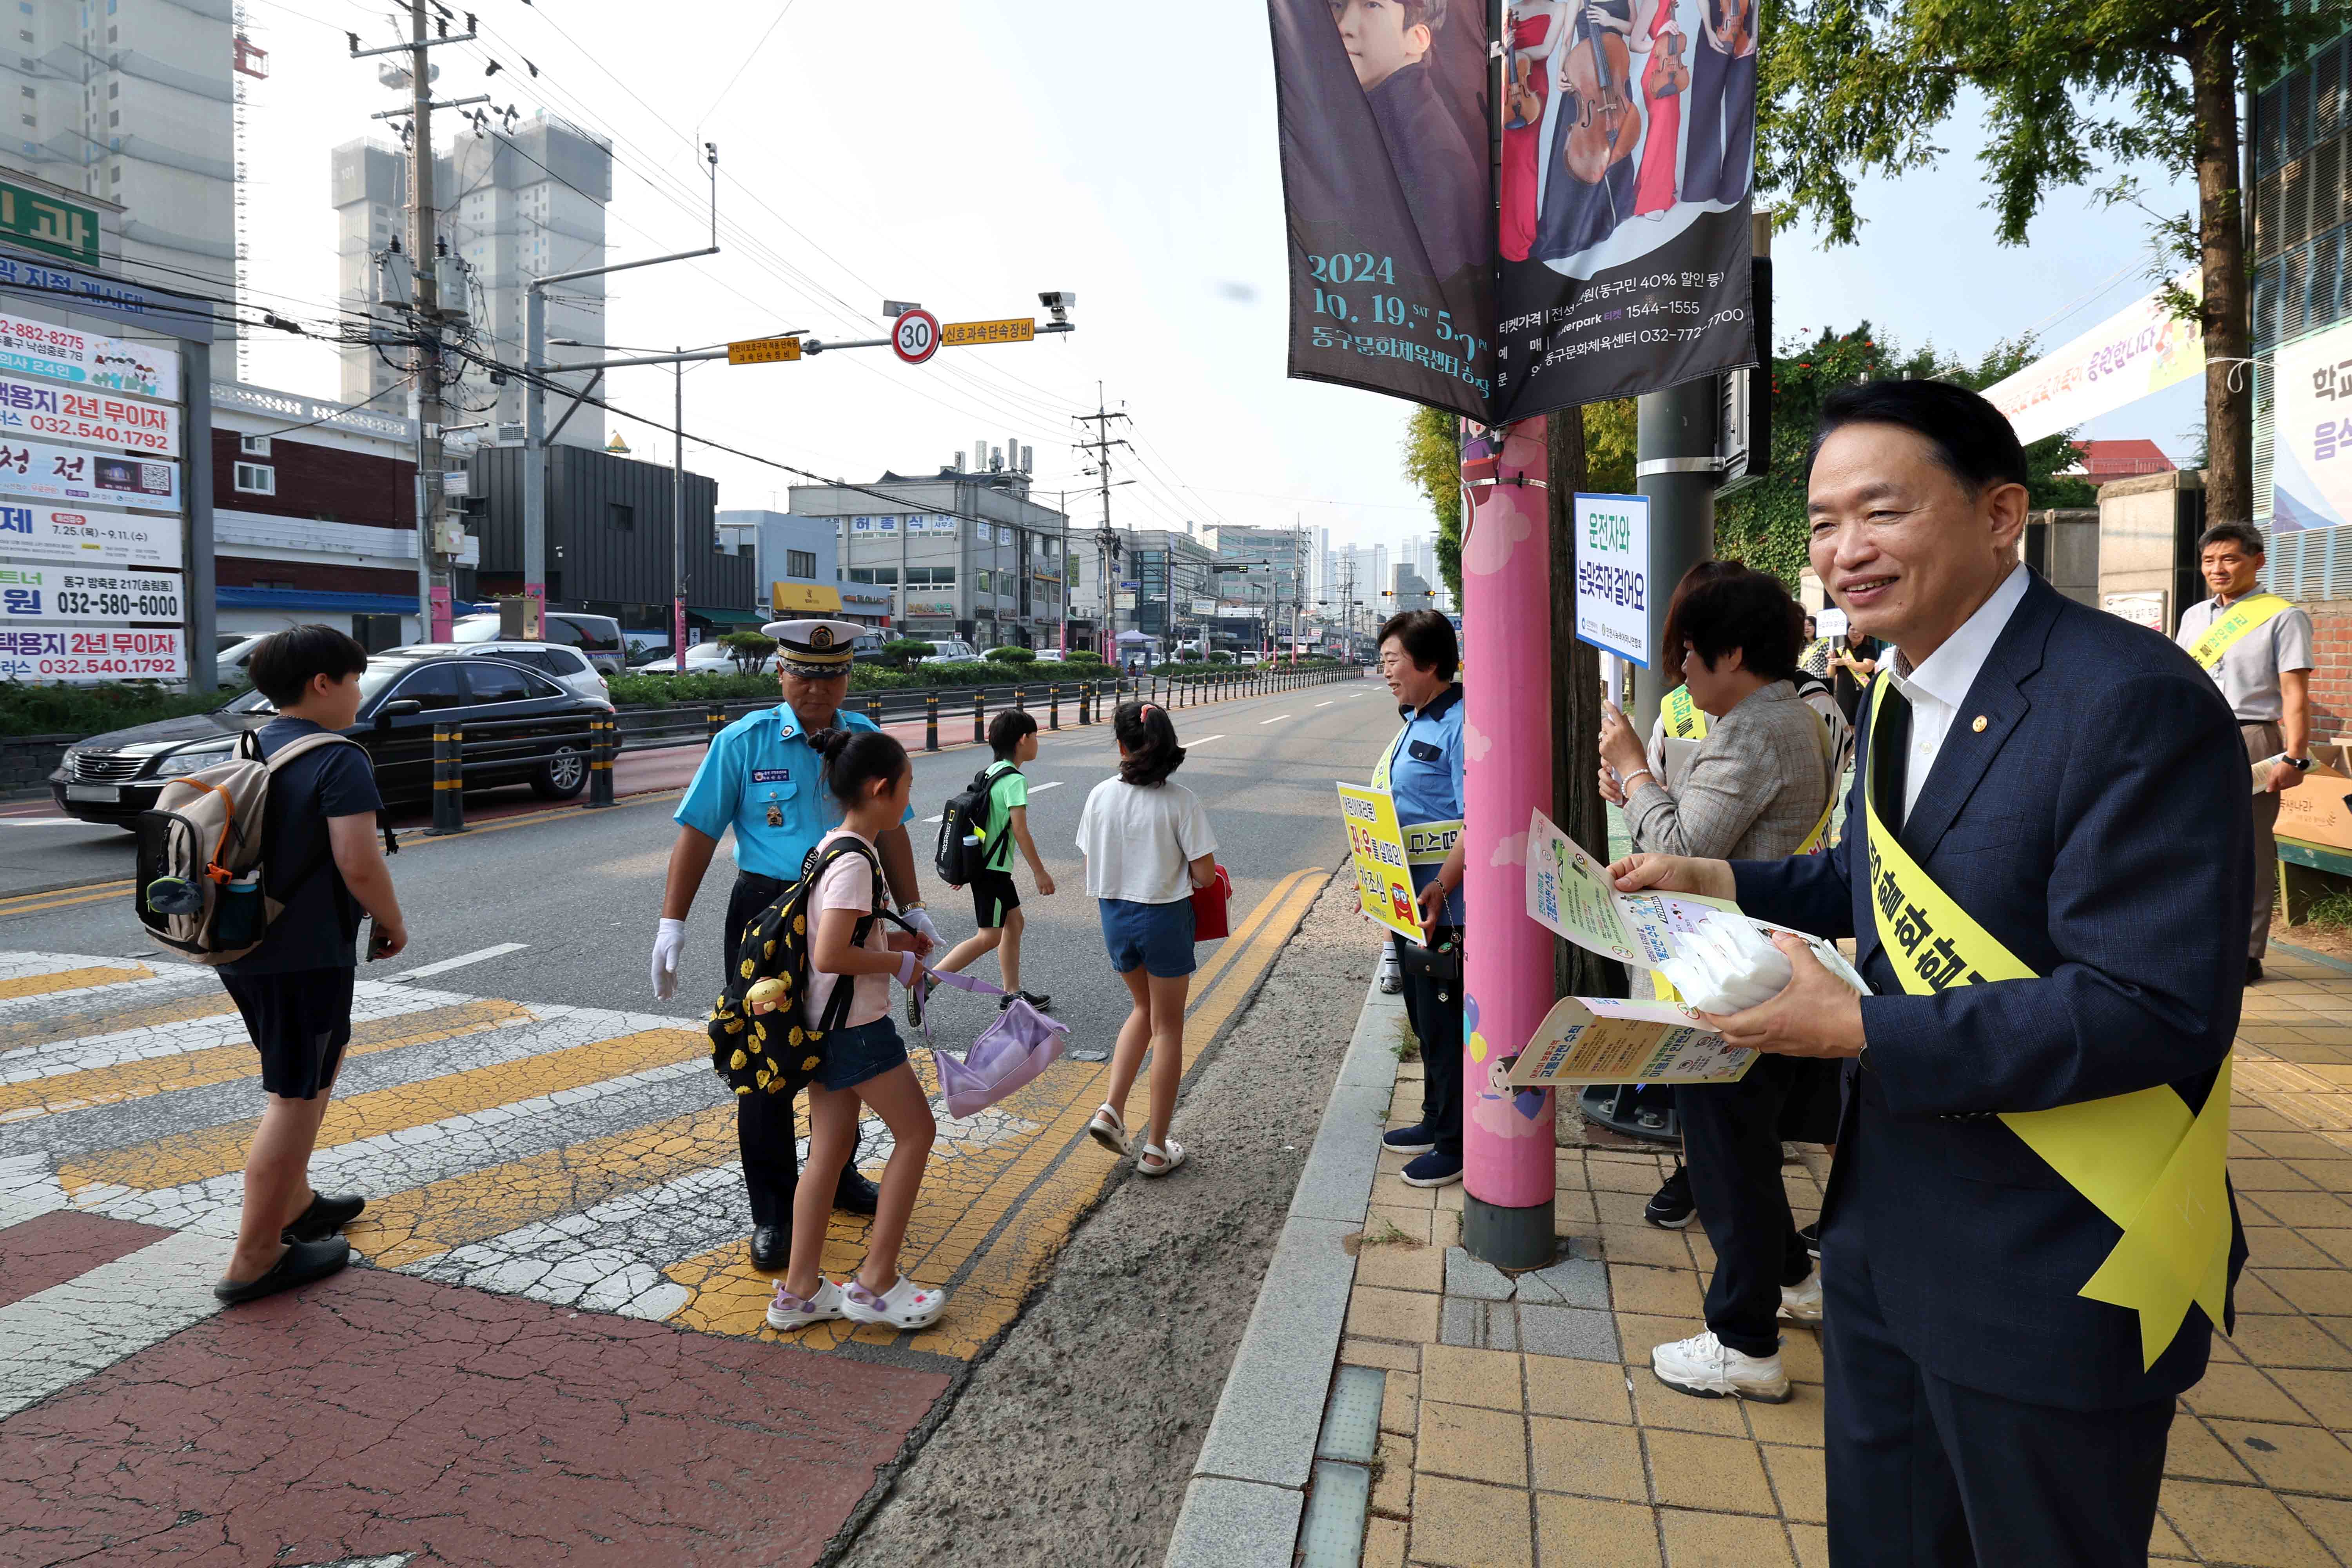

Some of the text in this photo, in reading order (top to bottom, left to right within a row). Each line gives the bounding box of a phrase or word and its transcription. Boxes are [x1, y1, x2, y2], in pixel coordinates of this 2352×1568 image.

[2, 191, 91, 256] 과
[1308, 252, 1396, 285] 2024
[1412, 304, 1430, 318] SAT
[1499, 311, 1541, 334] 티켓가격
[1640, 273, 1677, 289] 40%
[1681, 271, 1704, 287] 할인
[1706, 271, 1724, 288] 등)
[901, 323, 929, 349] 30
[946, 321, 1031, 343] 신호과속단속장비
[1498, 347, 1508, 360] 예
[1530, 338, 1542, 351] 매
[1604, 308, 1622, 321] 티켓
[1627, 301, 1700, 319] 1544-1555
[26, 340, 67, 359] 낙섬중로
[1311, 326, 1459, 377] 동구문화체육센터
[1498, 371, 1508, 388] 문
[1544, 330, 1637, 367] 동구문화체육센터
[2088, 325, 2155, 382] 응원합니다
[33, 360, 70, 377] 24인
[62, 393, 100, 420] 2년
[104, 400, 167, 432] 무이자
[31, 415, 169, 450] 032.540.1792
[856, 517, 870, 530] 허
[909, 515, 923, 529] 식
[1589, 512, 1630, 555] 운전자와
[64, 575, 85, 588] 동구
[88, 577, 118, 590] 방축로
[1579, 559, 1645, 612] 눈맞추며 걸어요
[4, 589, 178, 616] 원 032-580-6000
[71, 633, 108, 654] 2년
[112, 633, 176, 655] 무이자
[39, 659, 176, 675] 032.540.1792
[1359, 865, 1387, 904] 차조심
[1544, 871, 1558, 924] 교통안전 수칙
[1643, 924, 1660, 938] 수칙
[1529, 1040, 1561, 1078] 어린이 보호구역
[1539, 1025, 1584, 1078] 교통안전 수칙
[1649, 1054, 1676, 1077] 이용시
